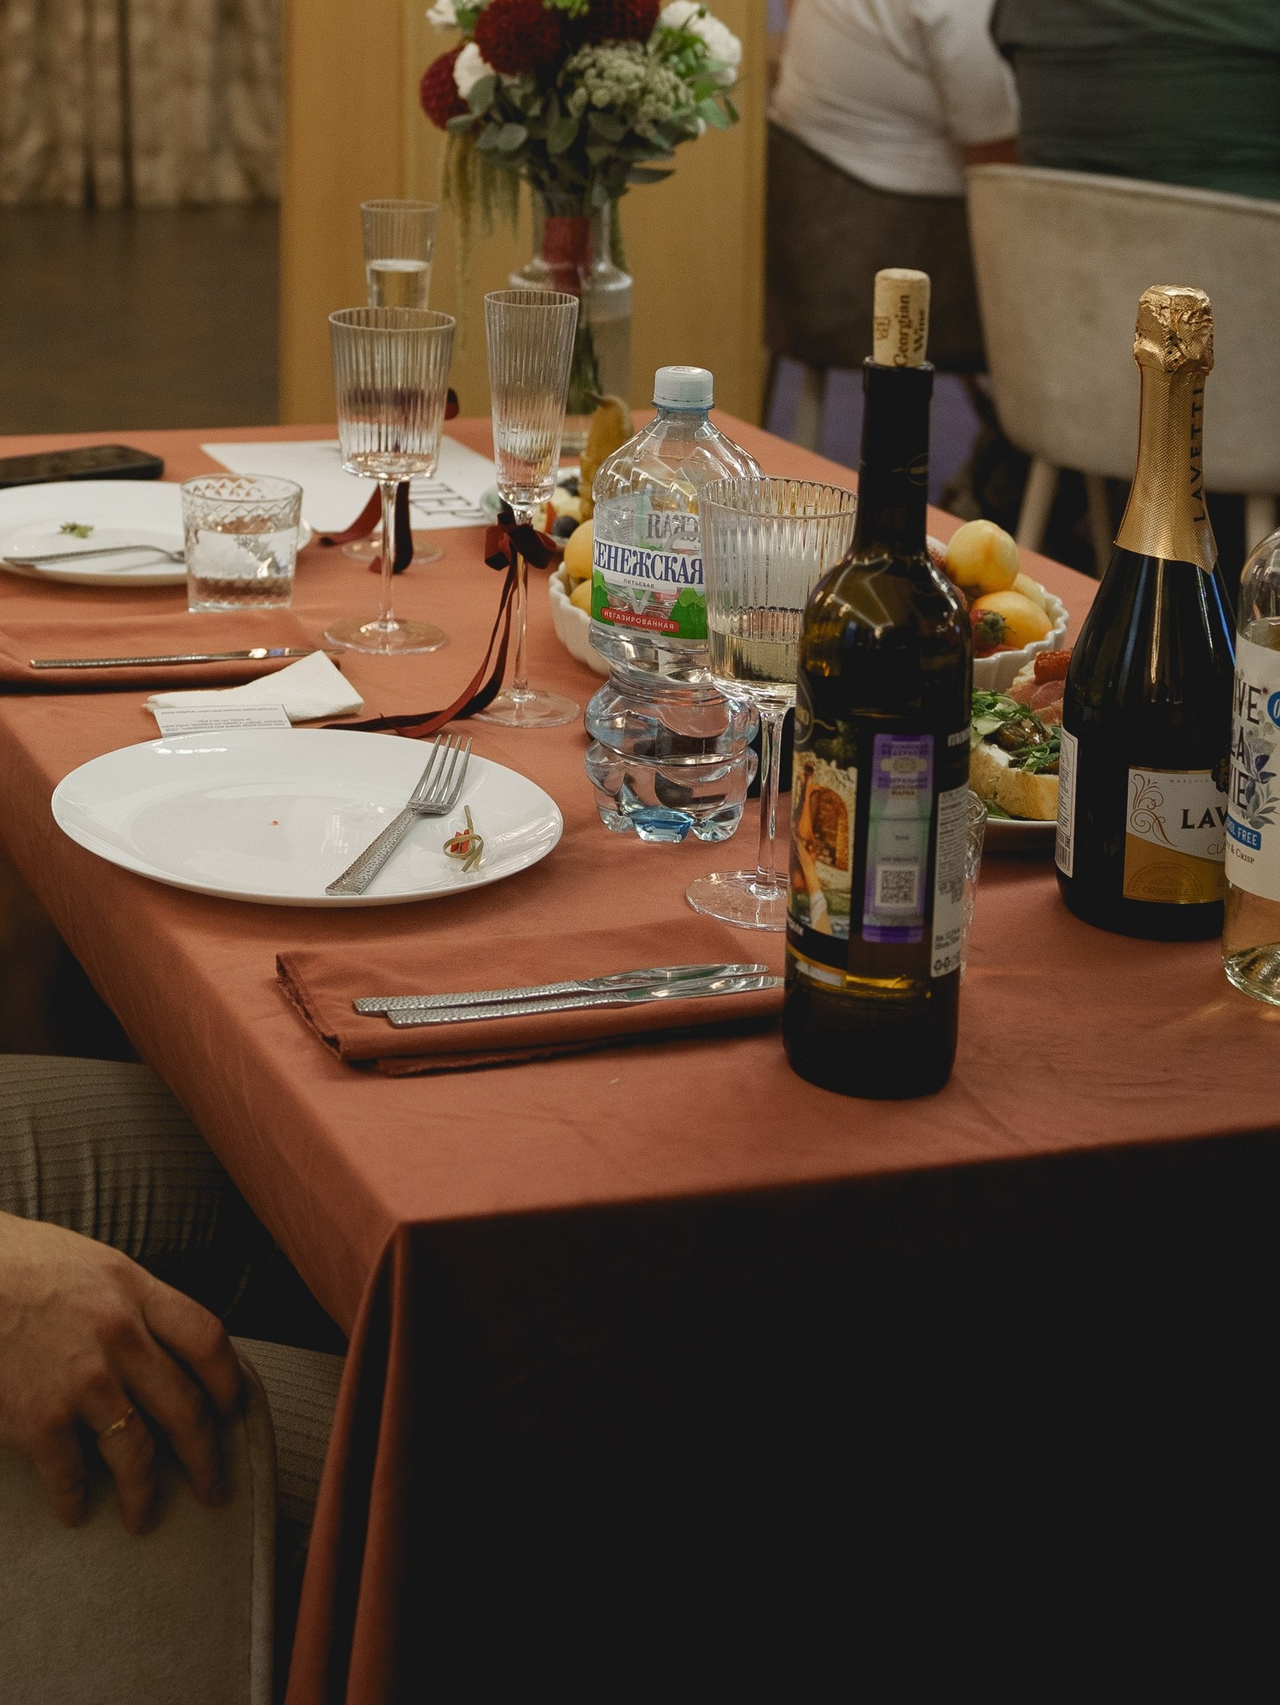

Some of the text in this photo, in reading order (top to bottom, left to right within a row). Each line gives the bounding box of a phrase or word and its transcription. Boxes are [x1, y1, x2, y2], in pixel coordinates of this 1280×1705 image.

[1191, 389, 1205, 522] LAVETTI
[623, 578, 655, 589] ПИТЬЕВАЯ
[604, 610, 675, 630] НЕГАЗИРОВАННАЯ
[1237, 826, 1258, 846] FREE
